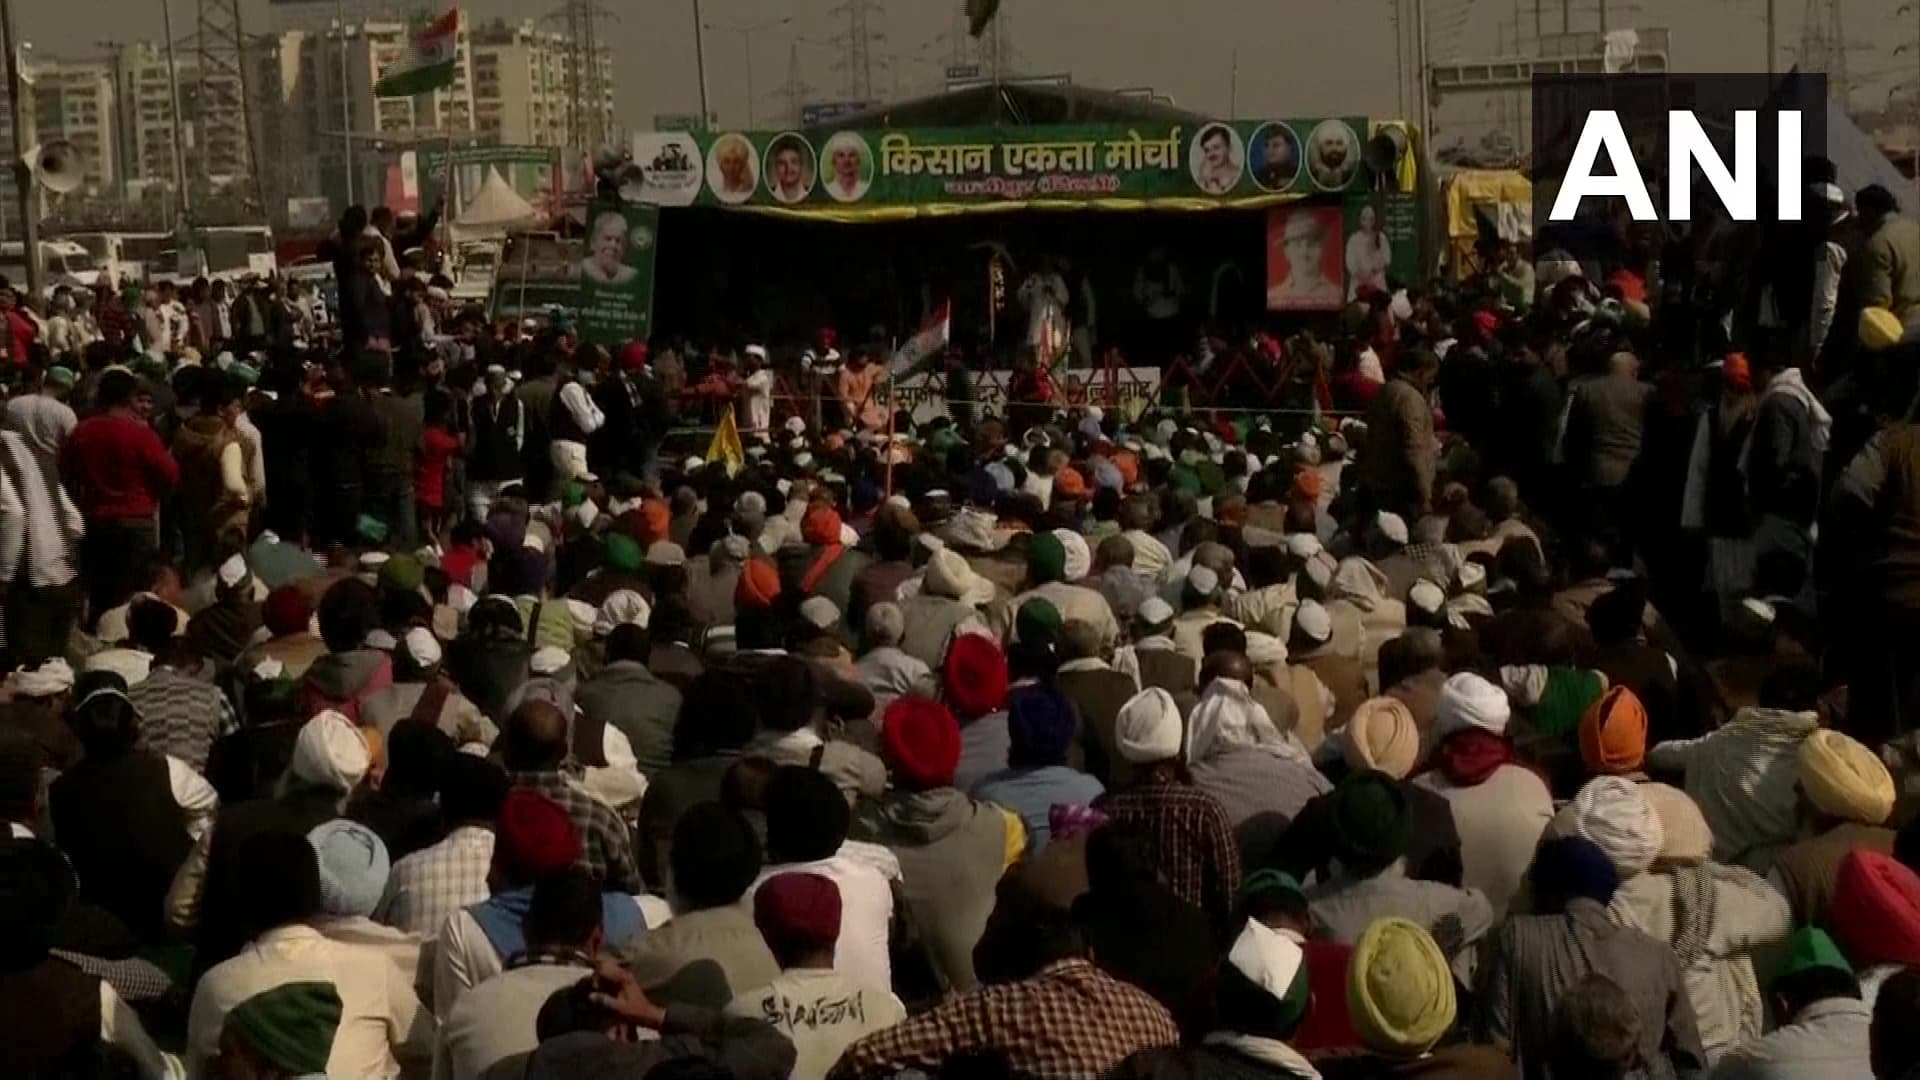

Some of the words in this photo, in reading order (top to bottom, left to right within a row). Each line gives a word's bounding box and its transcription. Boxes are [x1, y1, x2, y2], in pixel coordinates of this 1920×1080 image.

[880, 134, 993, 175] किसान
[1001, 142, 1097, 174] एकता
[1104, 127, 1182, 170] मोर्चा
